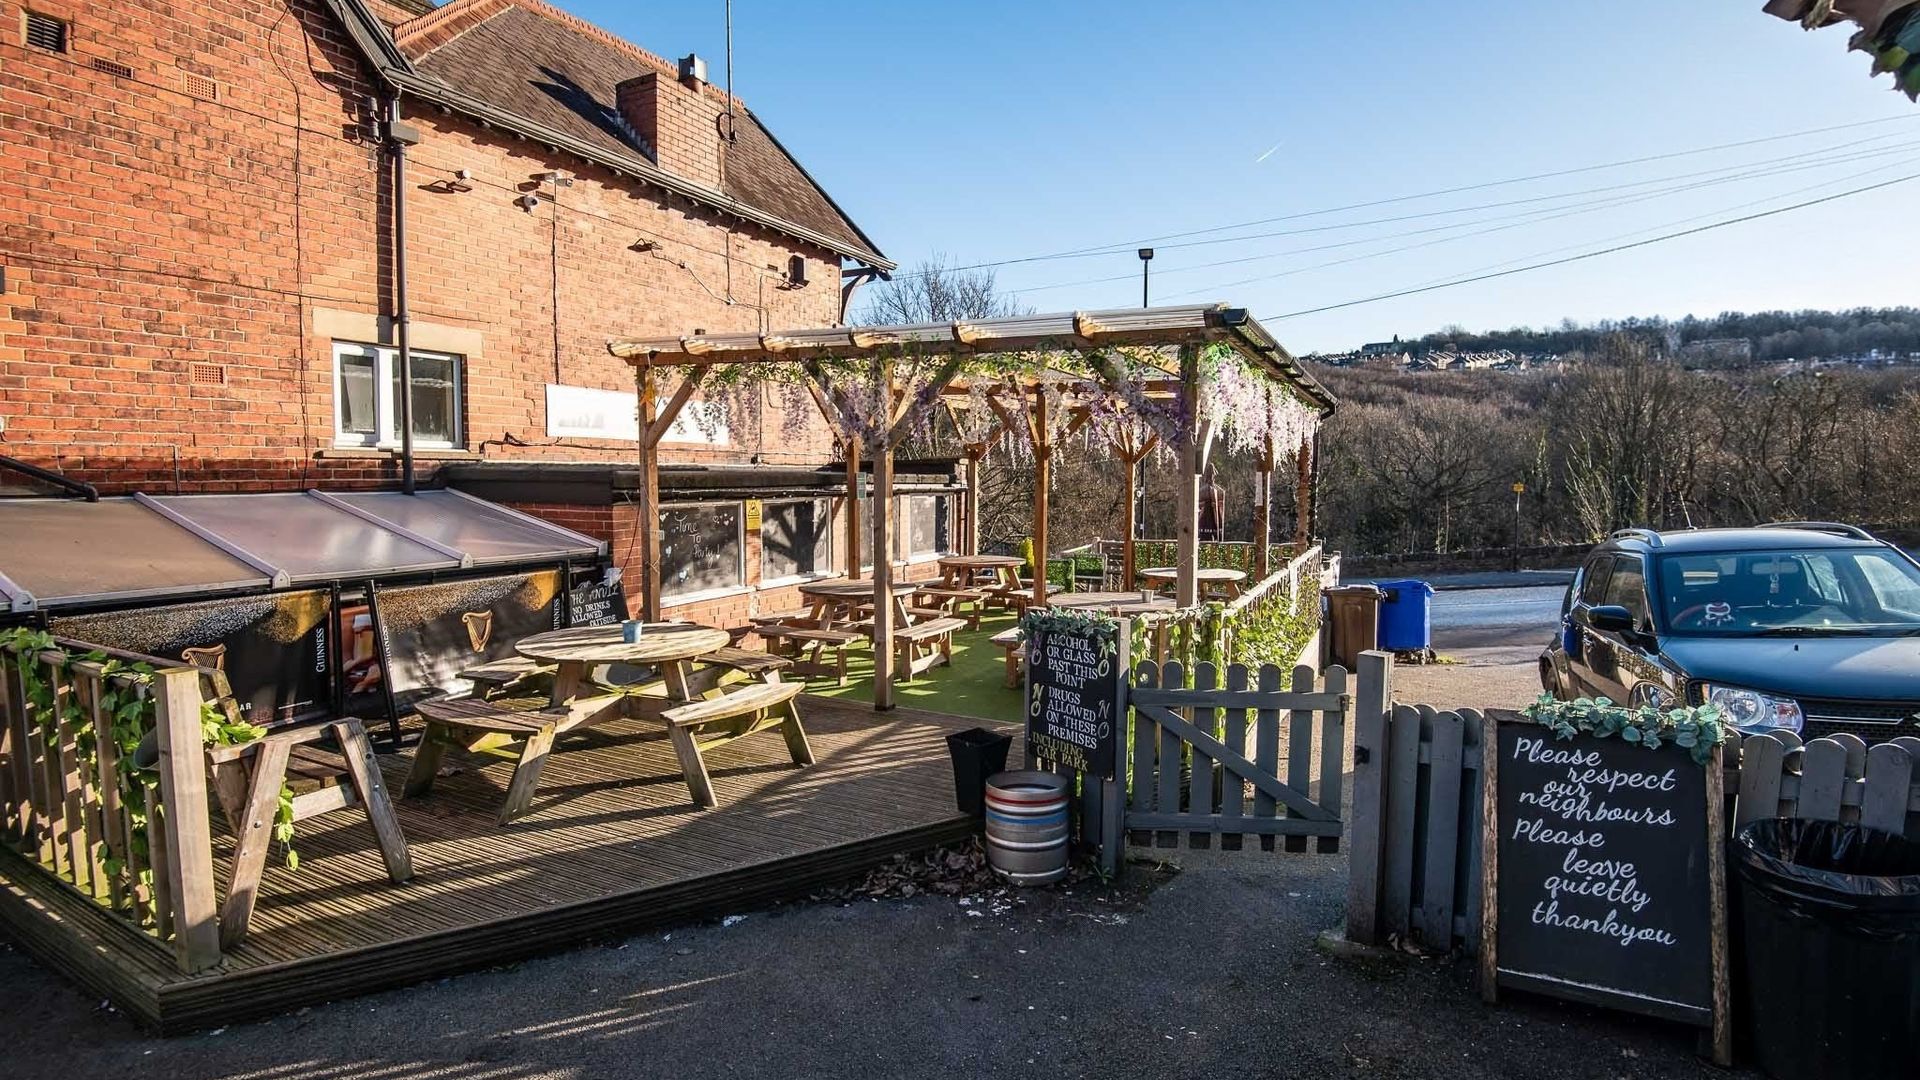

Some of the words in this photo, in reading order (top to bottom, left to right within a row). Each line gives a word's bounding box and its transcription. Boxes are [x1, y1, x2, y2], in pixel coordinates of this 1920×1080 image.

[571, 610, 602, 624] ALLOWED
[572, 605, 582, 615] NO
[585, 601, 610, 612] DRINKS
[589, 615, 617, 627] OUTSIDE
[315, 627, 326, 673] GUINNESS
[1046, 634, 1091, 651] ALCOHOL
[1046, 645, 1060, 661] OR
[1062, 649, 1096, 665] GLASS
[1048, 658, 1071, 673] PAST
[1073, 663, 1098, 680] THIS
[1055, 672, 1086, 690] POINT
[1048, 686, 1080, 705] DRUGS
[1046, 710, 1059, 723] ON
[1063, 715, 1097, 736] THESE
[1047, 699, 1096, 722] ALLOWED
[1032, 731, 1083, 758] INCLUDING
[1048, 723, 1097, 750] PREMISES
[1037, 746, 1057, 761] CAR
[1061, 753, 1088, 772] PARK
[1513, 736, 1603, 767] Please
[1543, 780, 1592, 799] our
[1567, 767, 1677, 793] respect
[1519, 791, 1677, 826] neighbours
[1512, 818, 1605, 848] Please
[1563, 848, 1637, 878] leave
[1544, 876, 1652, 913] quietly
[1531, 900, 1678, 947] thankyou
